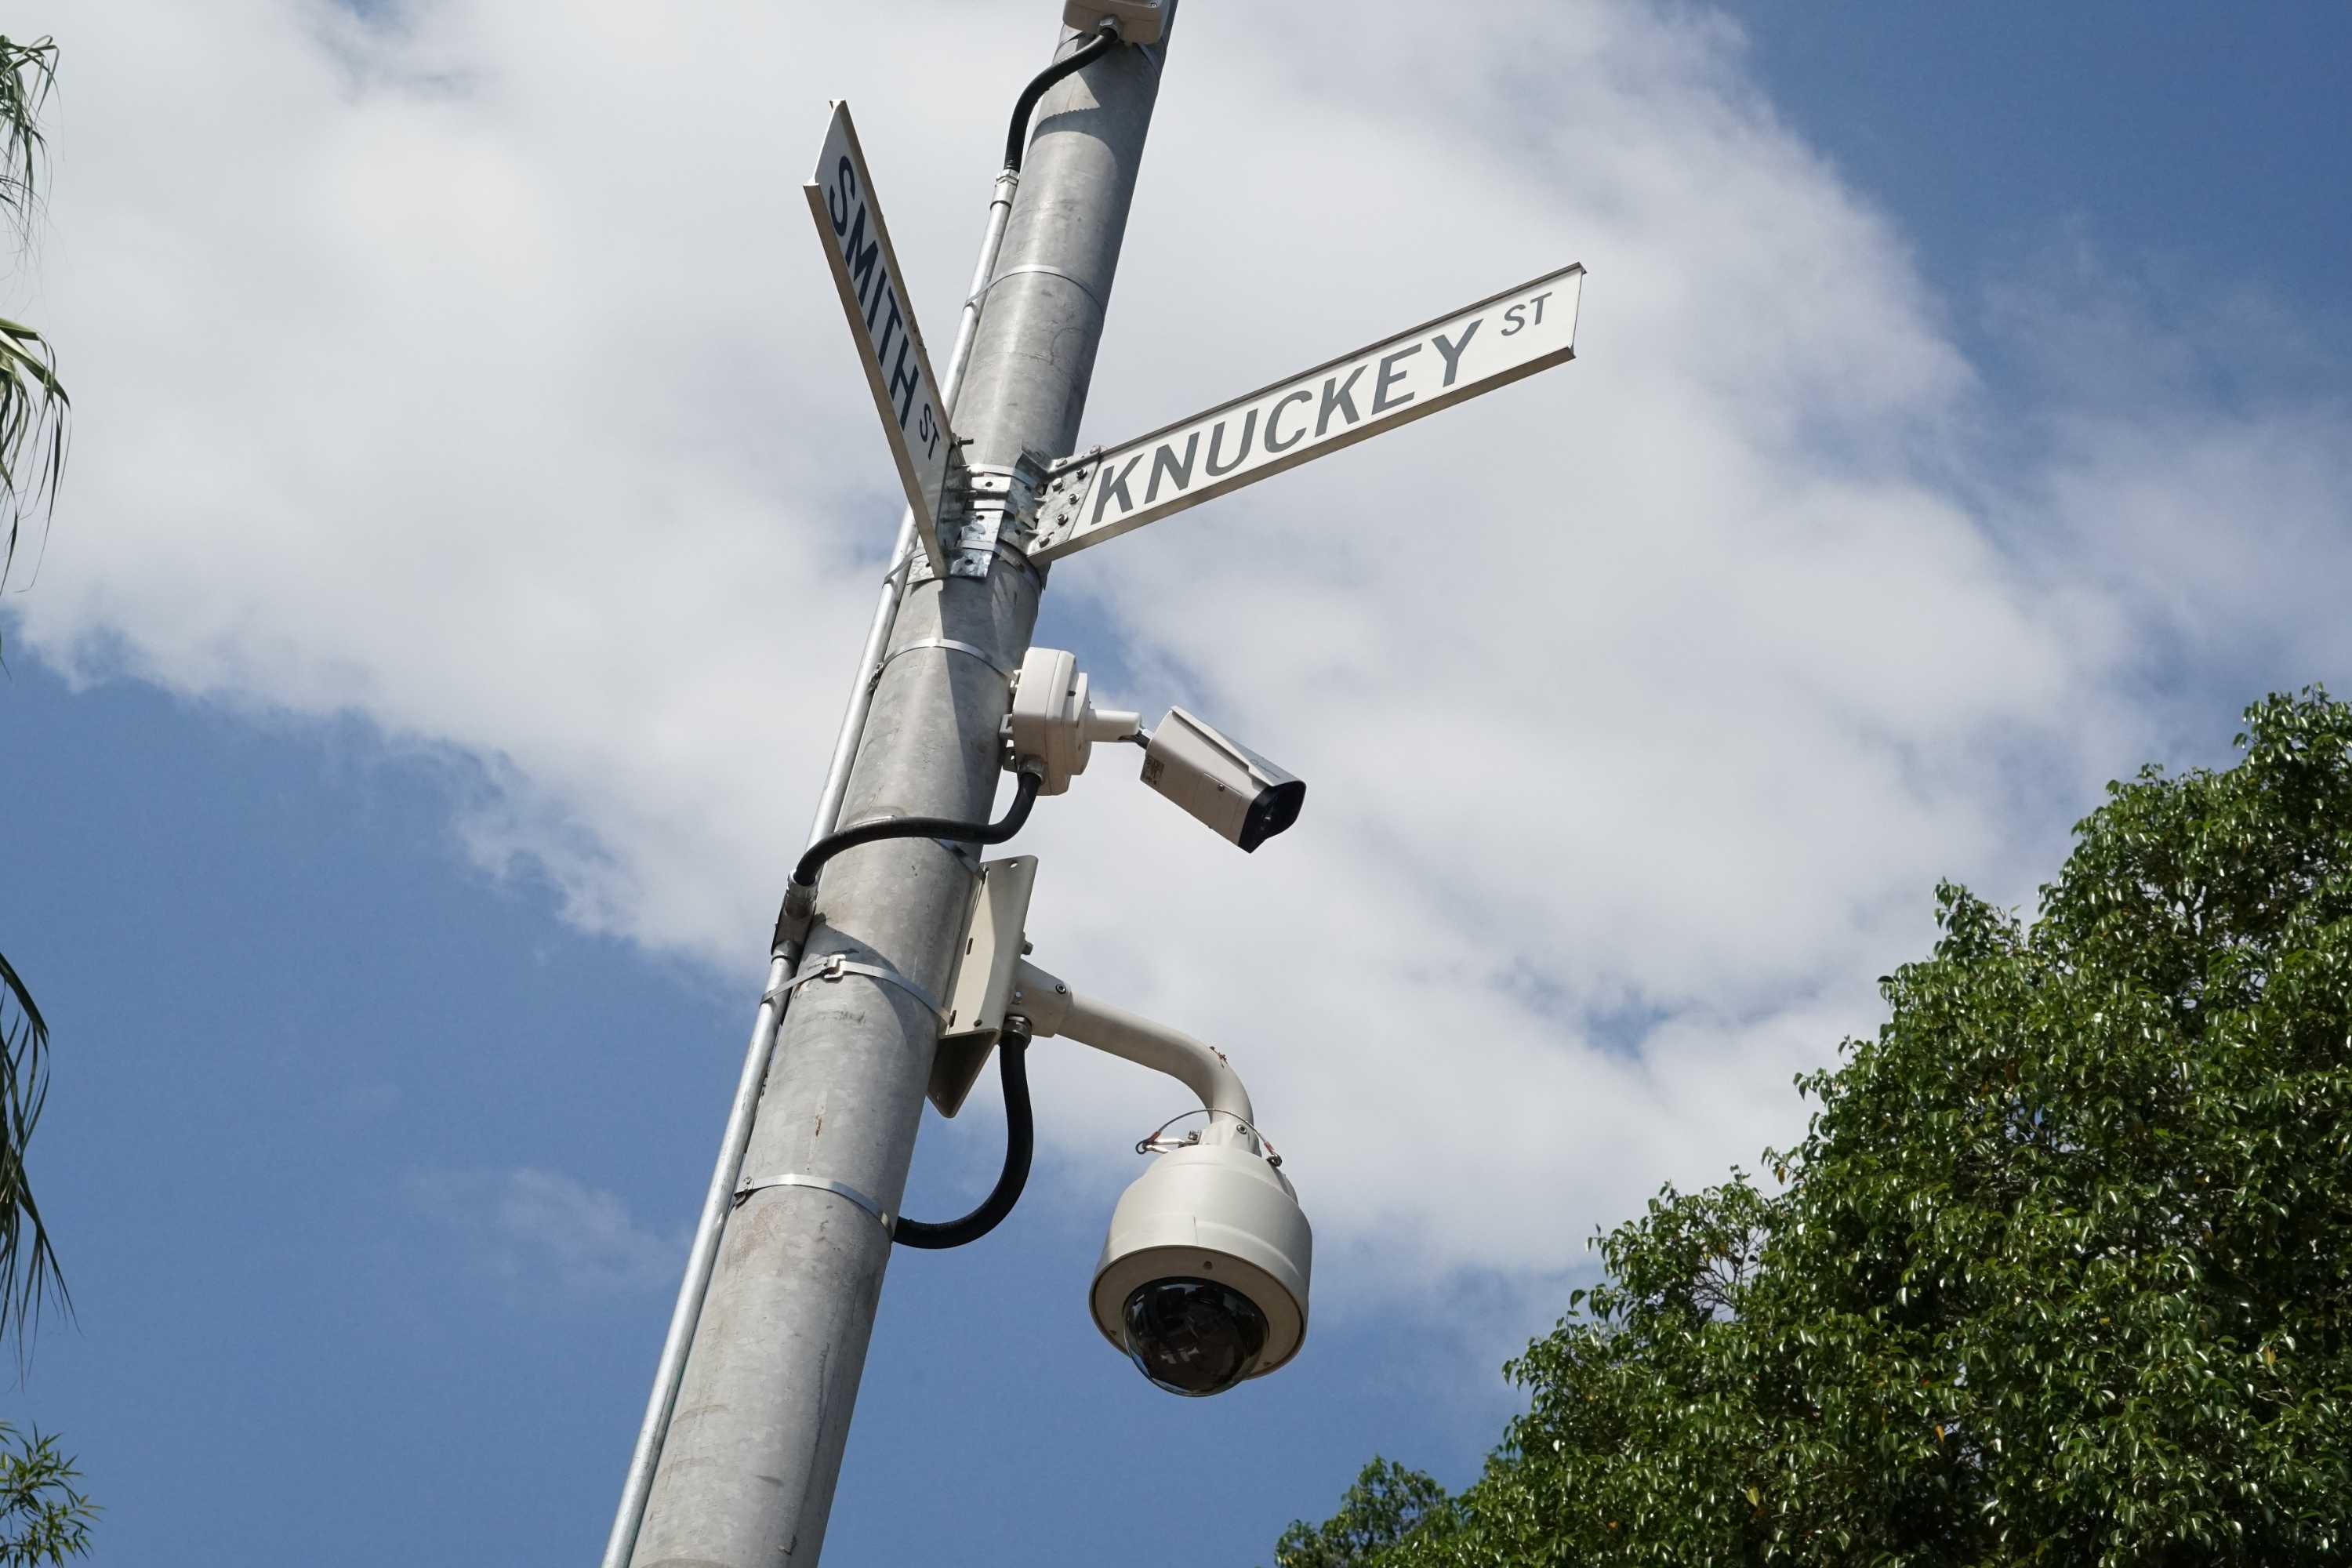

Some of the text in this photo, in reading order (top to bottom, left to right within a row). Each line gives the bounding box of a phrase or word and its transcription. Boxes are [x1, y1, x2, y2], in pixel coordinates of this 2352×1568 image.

[829, 155, 940, 460] SMITH ST
[1091, 292, 1552, 524] KNUCKEY ST
